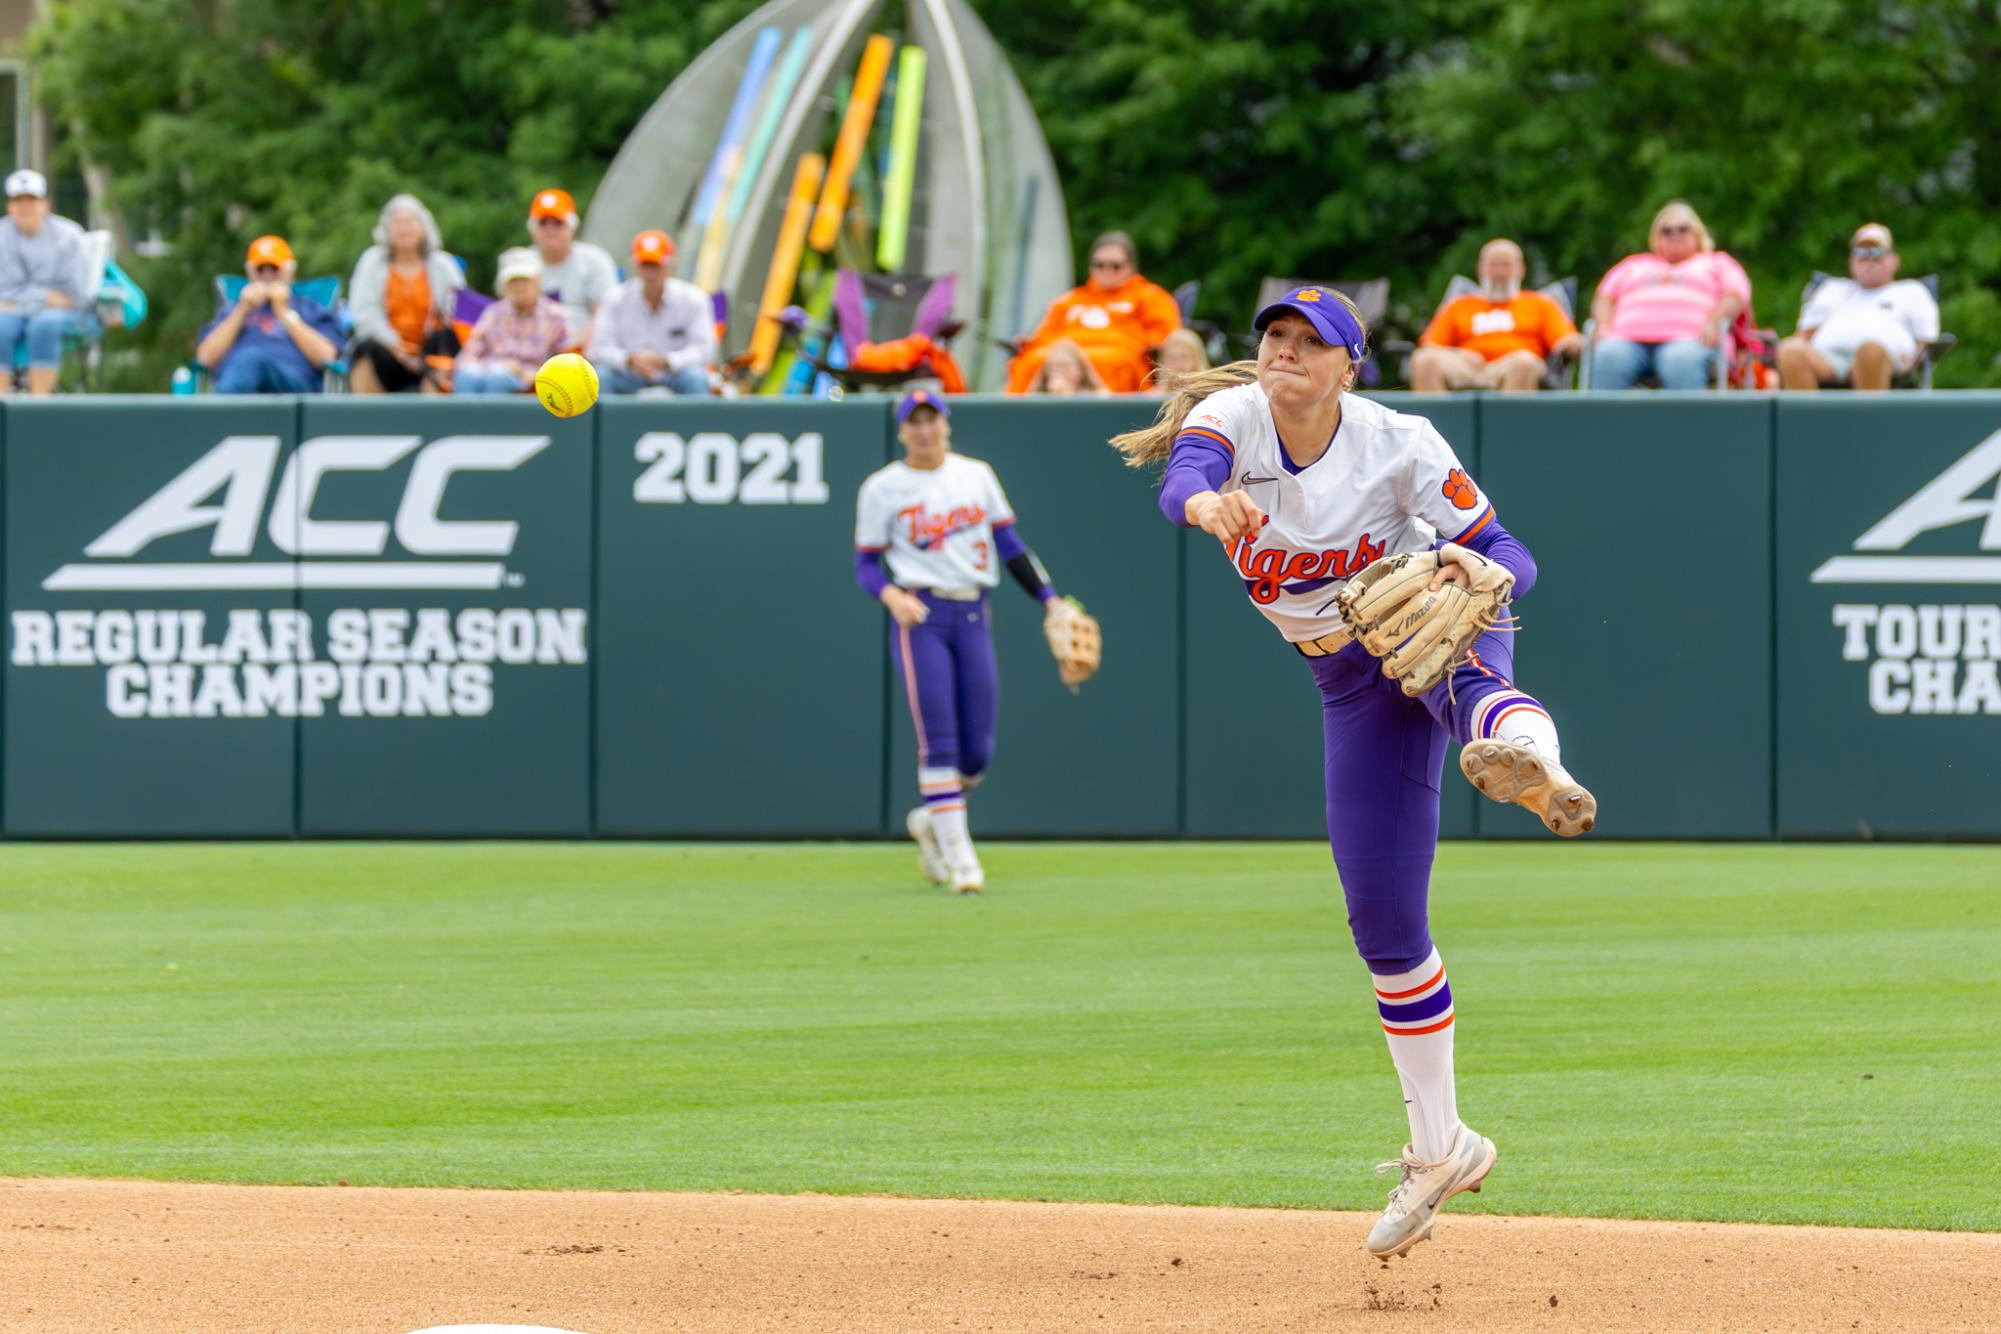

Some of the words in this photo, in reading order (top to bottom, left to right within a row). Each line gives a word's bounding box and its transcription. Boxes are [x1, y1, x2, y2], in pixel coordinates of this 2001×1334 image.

[1199, 413, 1225, 428] ACC
[85, 435, 549, 557] ACC
[633, 432, 829, 504] 2021
[971, 539, 989, 571] 3
[12, 609, 315, 666] REGULAR
[327, 607, 589, 665] SEASON
[1832, 604, 2001, 661] TOUR
[106, 661, 495, 718] CHAMPIONS
[1868, 658, 2001, 715] CHA
